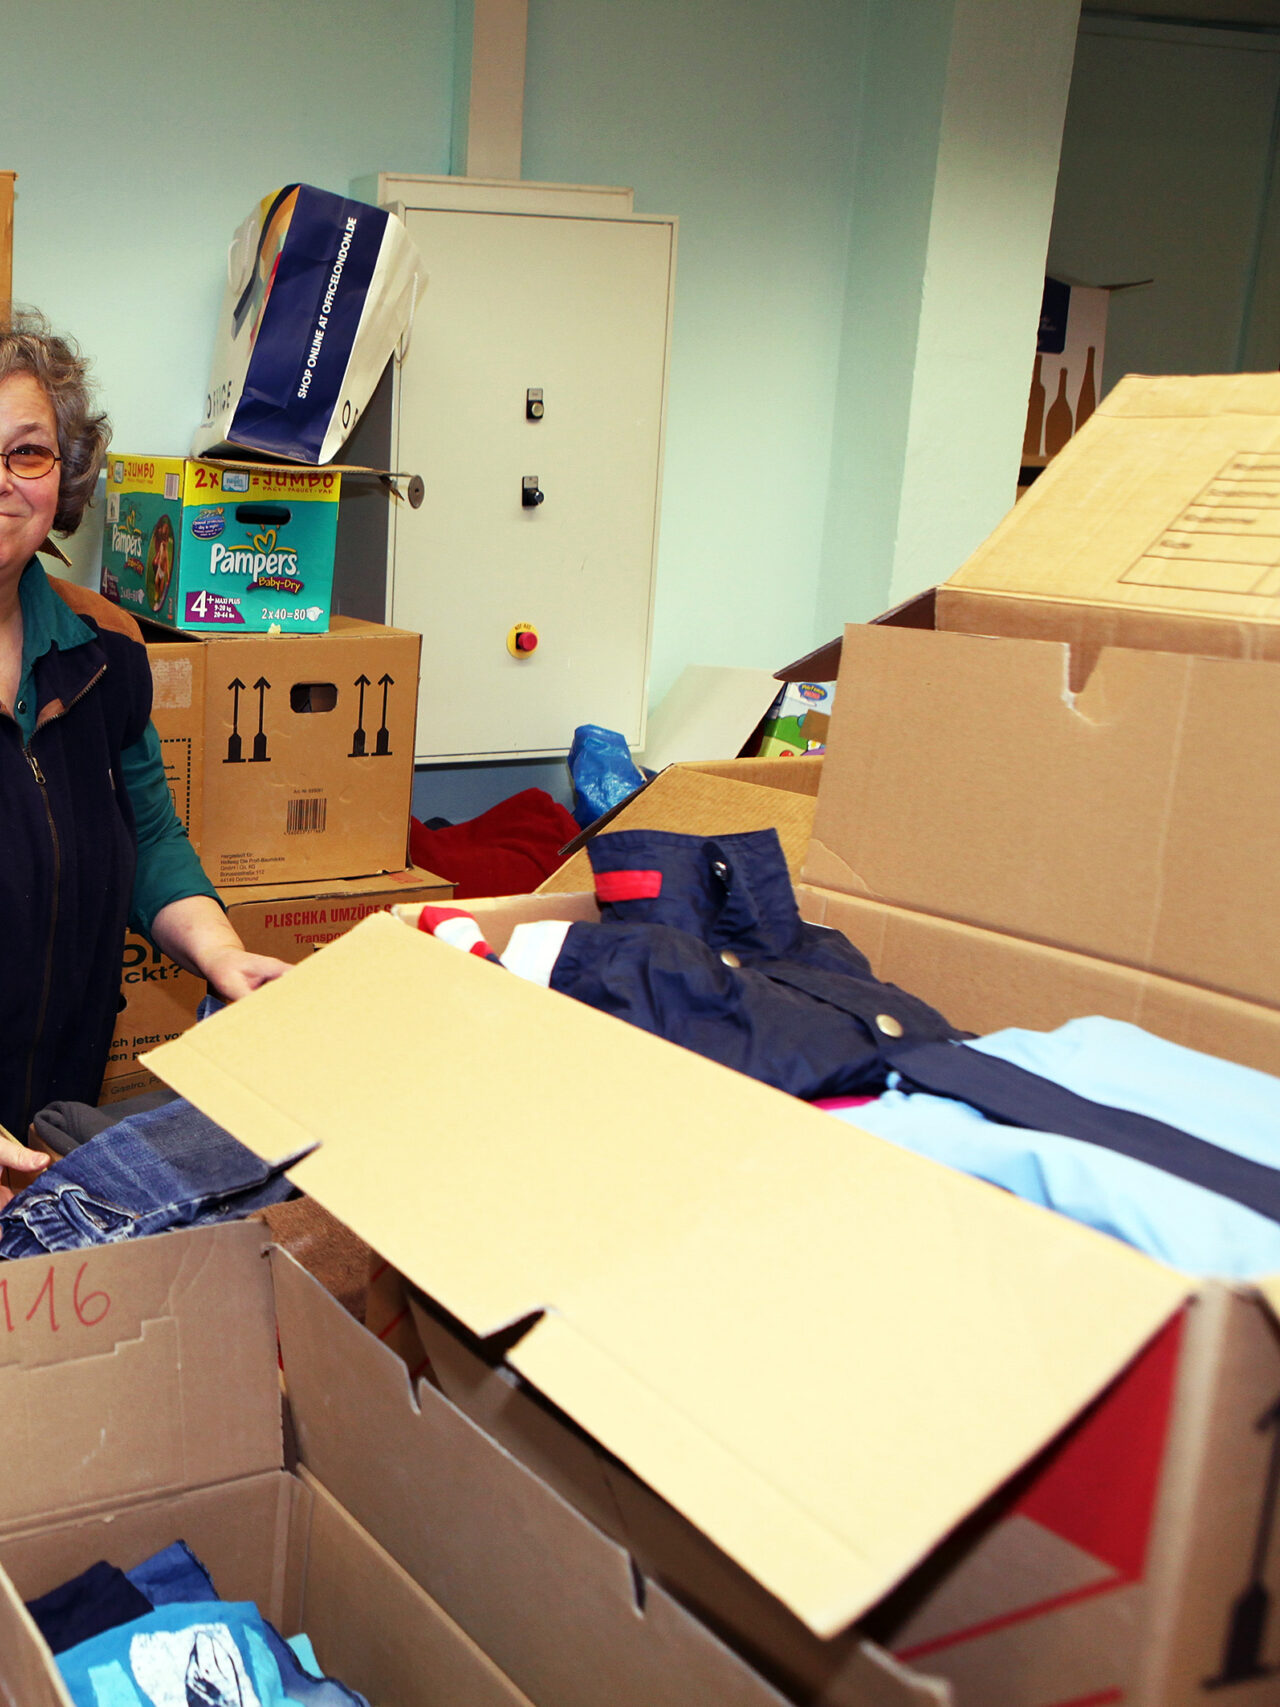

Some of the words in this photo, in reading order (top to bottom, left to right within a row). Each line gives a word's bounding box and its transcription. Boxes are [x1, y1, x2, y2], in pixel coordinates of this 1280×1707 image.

[321, 216, 357, 314] OFFICELONDON.DE
[317, 314, 329, 329] AT
[307, 327, 325, 368] ONLINE
[297, 369, 312, 399] SHOP
[263, 471, 334, 488] JUMBO
[210, 543, 298, 582] Pampers
[258, 576, 301, 594] Baby-Dry
[264, 910, 327, 928] PLISCHKA
[294, 931, 346, 944] Transpo
[124, 964, 183, 984] ckt?
[132, 1034, 160, 1047] jetzt
